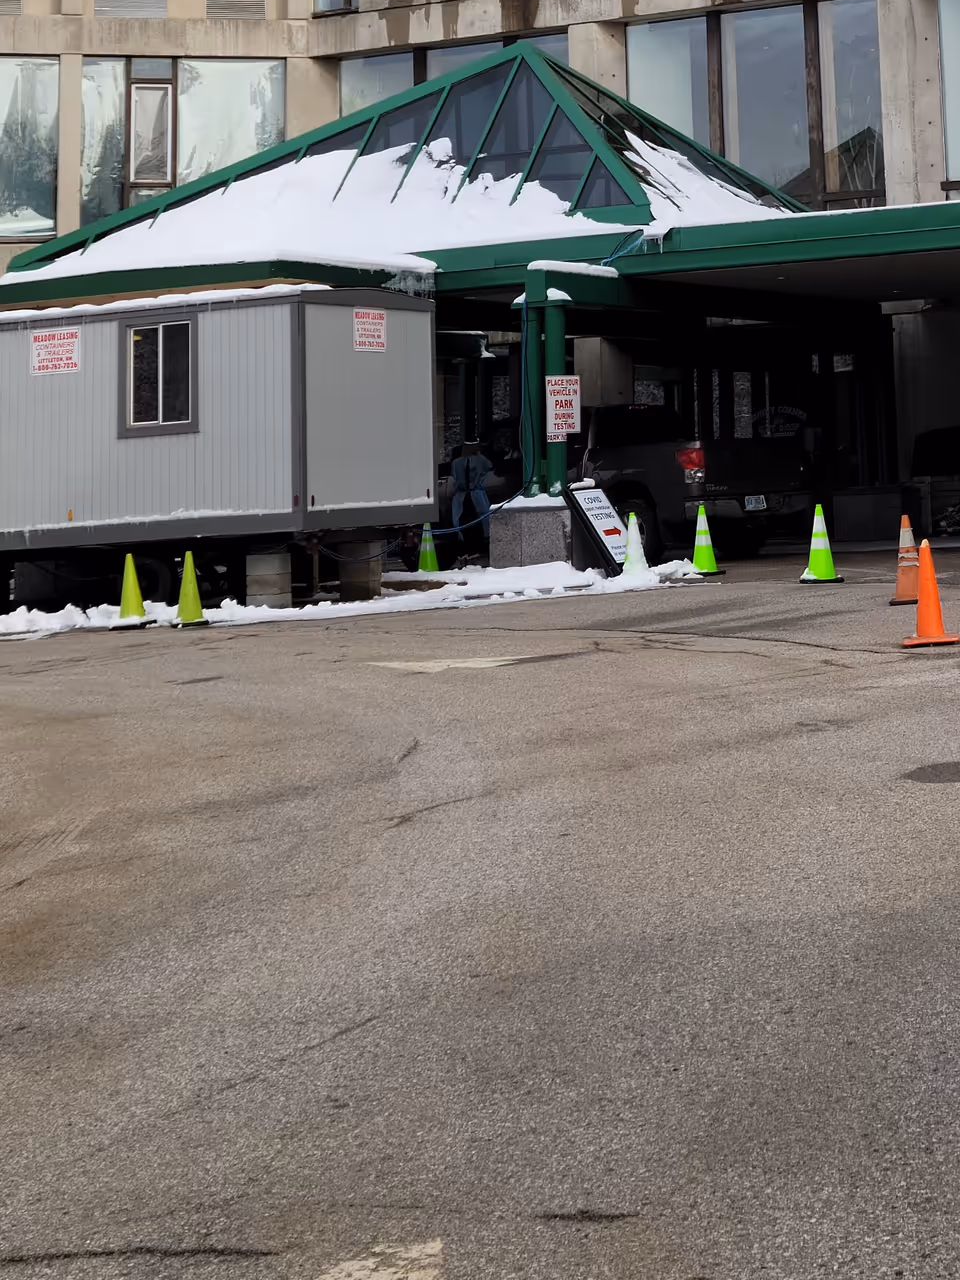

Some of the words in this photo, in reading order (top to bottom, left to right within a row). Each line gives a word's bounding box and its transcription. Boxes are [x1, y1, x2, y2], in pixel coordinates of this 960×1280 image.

[33, 333, 56, 342] MEADOW
[57, 331, 78, 340] LEASING
[36, 341, 75, 351] CONTAINERS
[44, 349, 74, 357] TRAILERS
[33, 362, 78, 371] 1-800-762-7026
[555, 399, 573, 409] PARK
[583, 496, 602, 505] COVID
[591, 511, 615, 521] TESTING
